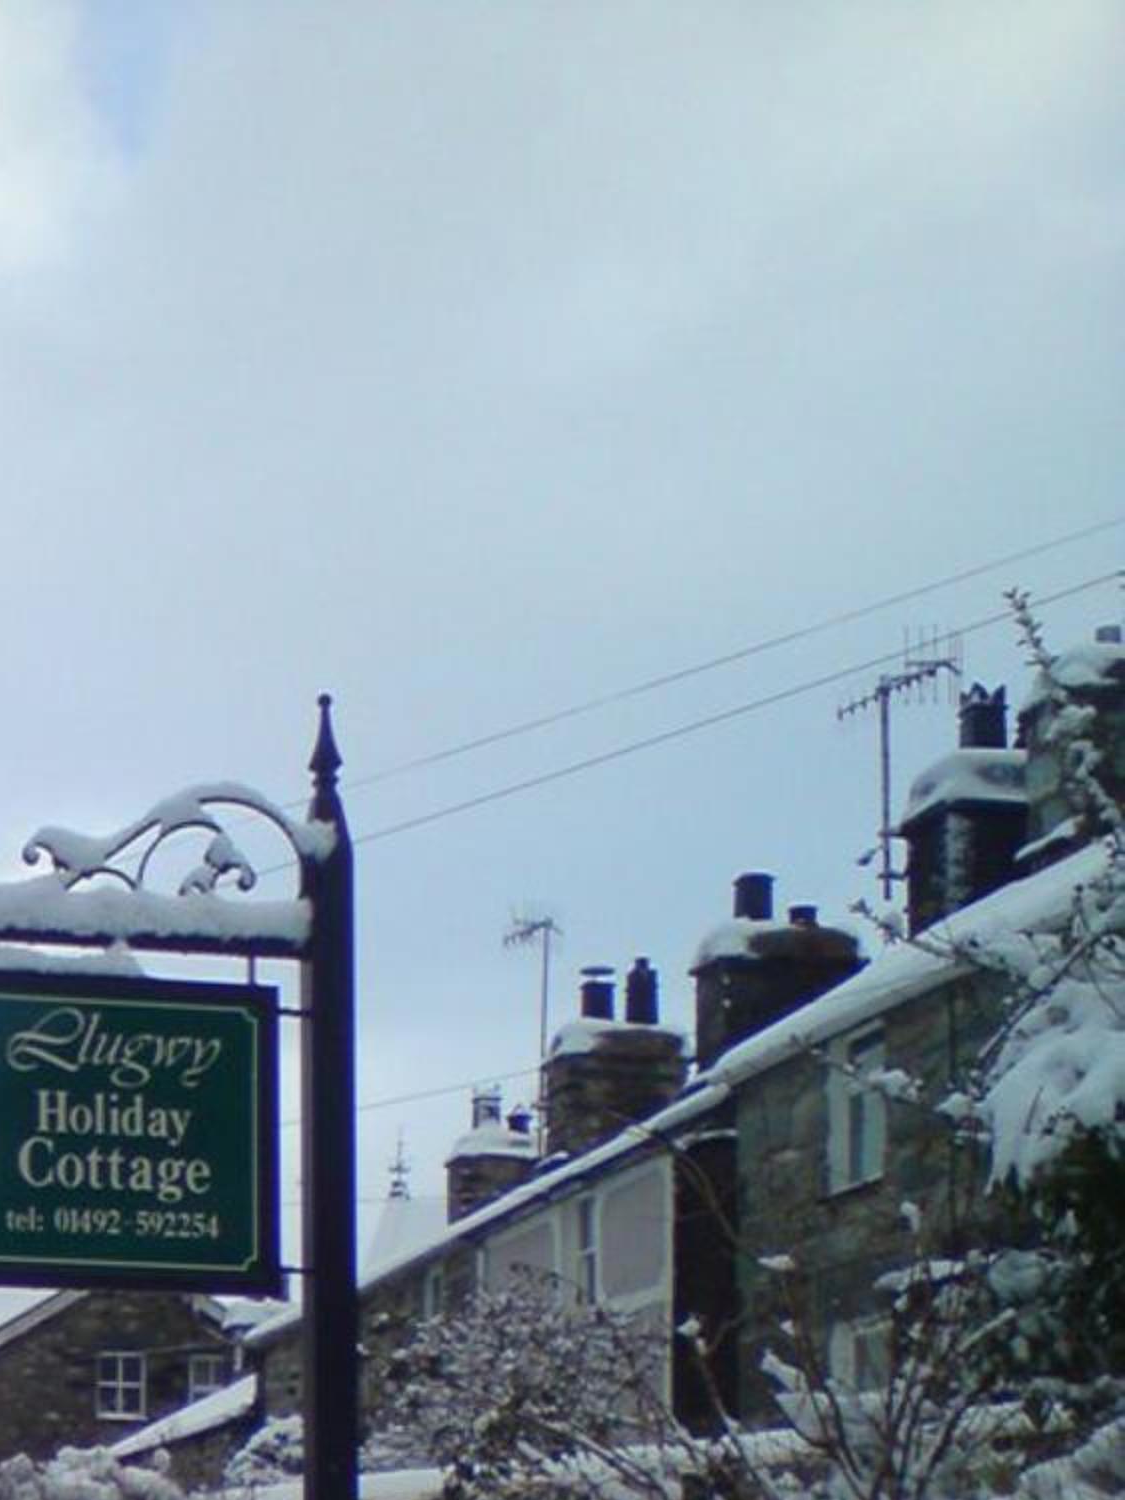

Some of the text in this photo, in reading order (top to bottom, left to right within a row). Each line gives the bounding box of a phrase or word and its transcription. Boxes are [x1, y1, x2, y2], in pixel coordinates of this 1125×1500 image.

[6, 1006, 222, 1088] Llugwy
[35, 1089, 191, 1146] Holiday
[17, 1136, 212, 1202] Cottage
[5, 1206, 44, 1232] tel:
